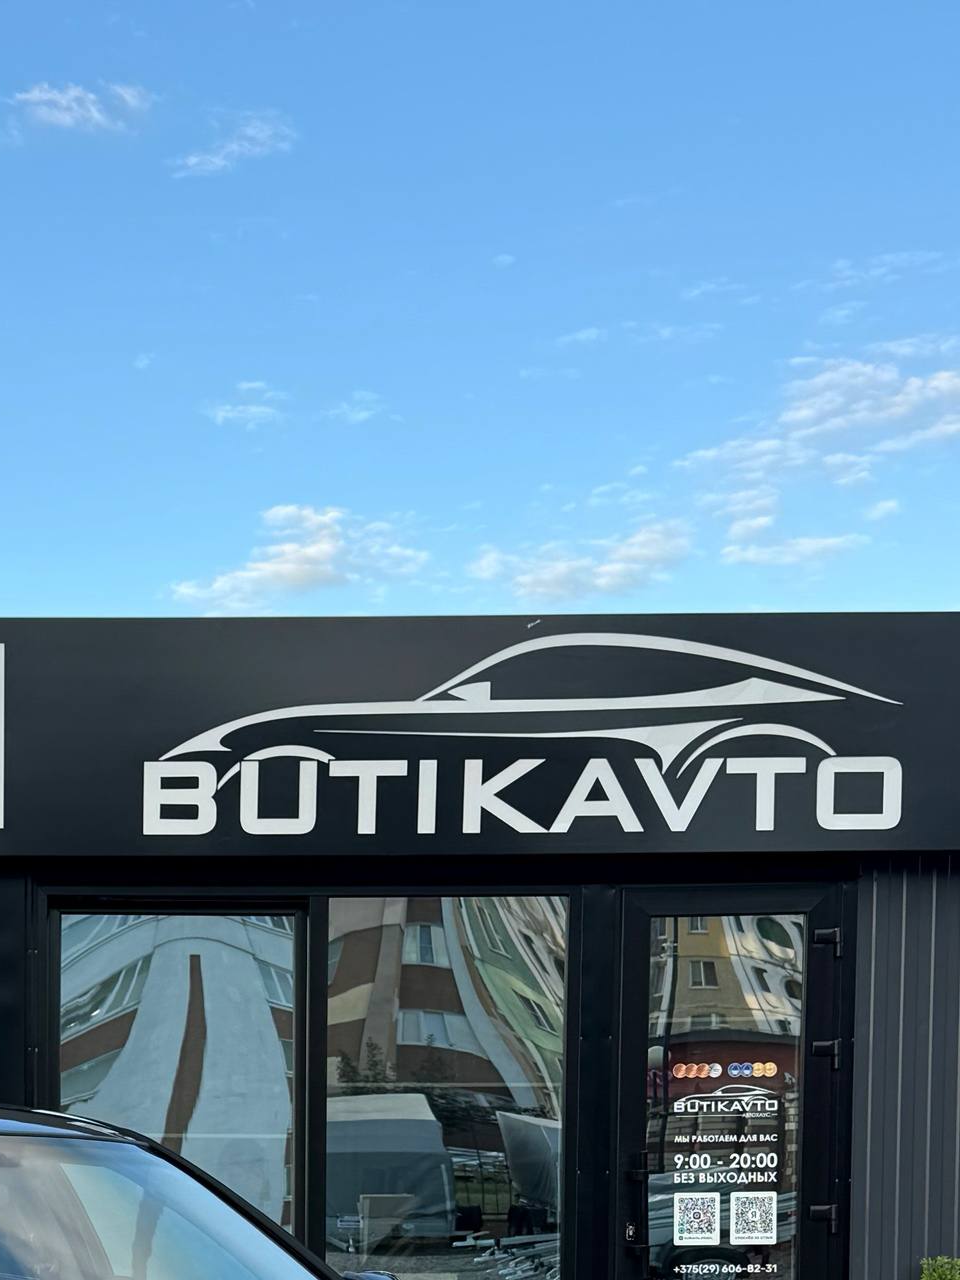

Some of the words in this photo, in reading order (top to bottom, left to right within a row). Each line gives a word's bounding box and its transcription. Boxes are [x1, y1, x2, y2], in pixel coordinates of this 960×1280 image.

[142, 755, 903, 836] BUTIKAVTO
[673, 1100, 779, 1112] BUTIKAVTO
[674, 1135, 690, 1143] МЫ
[691, 1134, 738, 1143] РАБОТАЕМ
[739, 1134, 757, 1143] ДЛЯ
[759, 1134, 779, 1142] ВАС
[673, 1153, 712, 1169] 9:00
[729, 1152, 779, 1169] 20:00
[673, 1172, 696, 1184] БЕЗ
[698, 1171, 778, 1184] ВЫХОДНЫХ
[673, 1264, 720, 1275] +375(29)
[721, 1263, 778, 1274] 606-82-31
